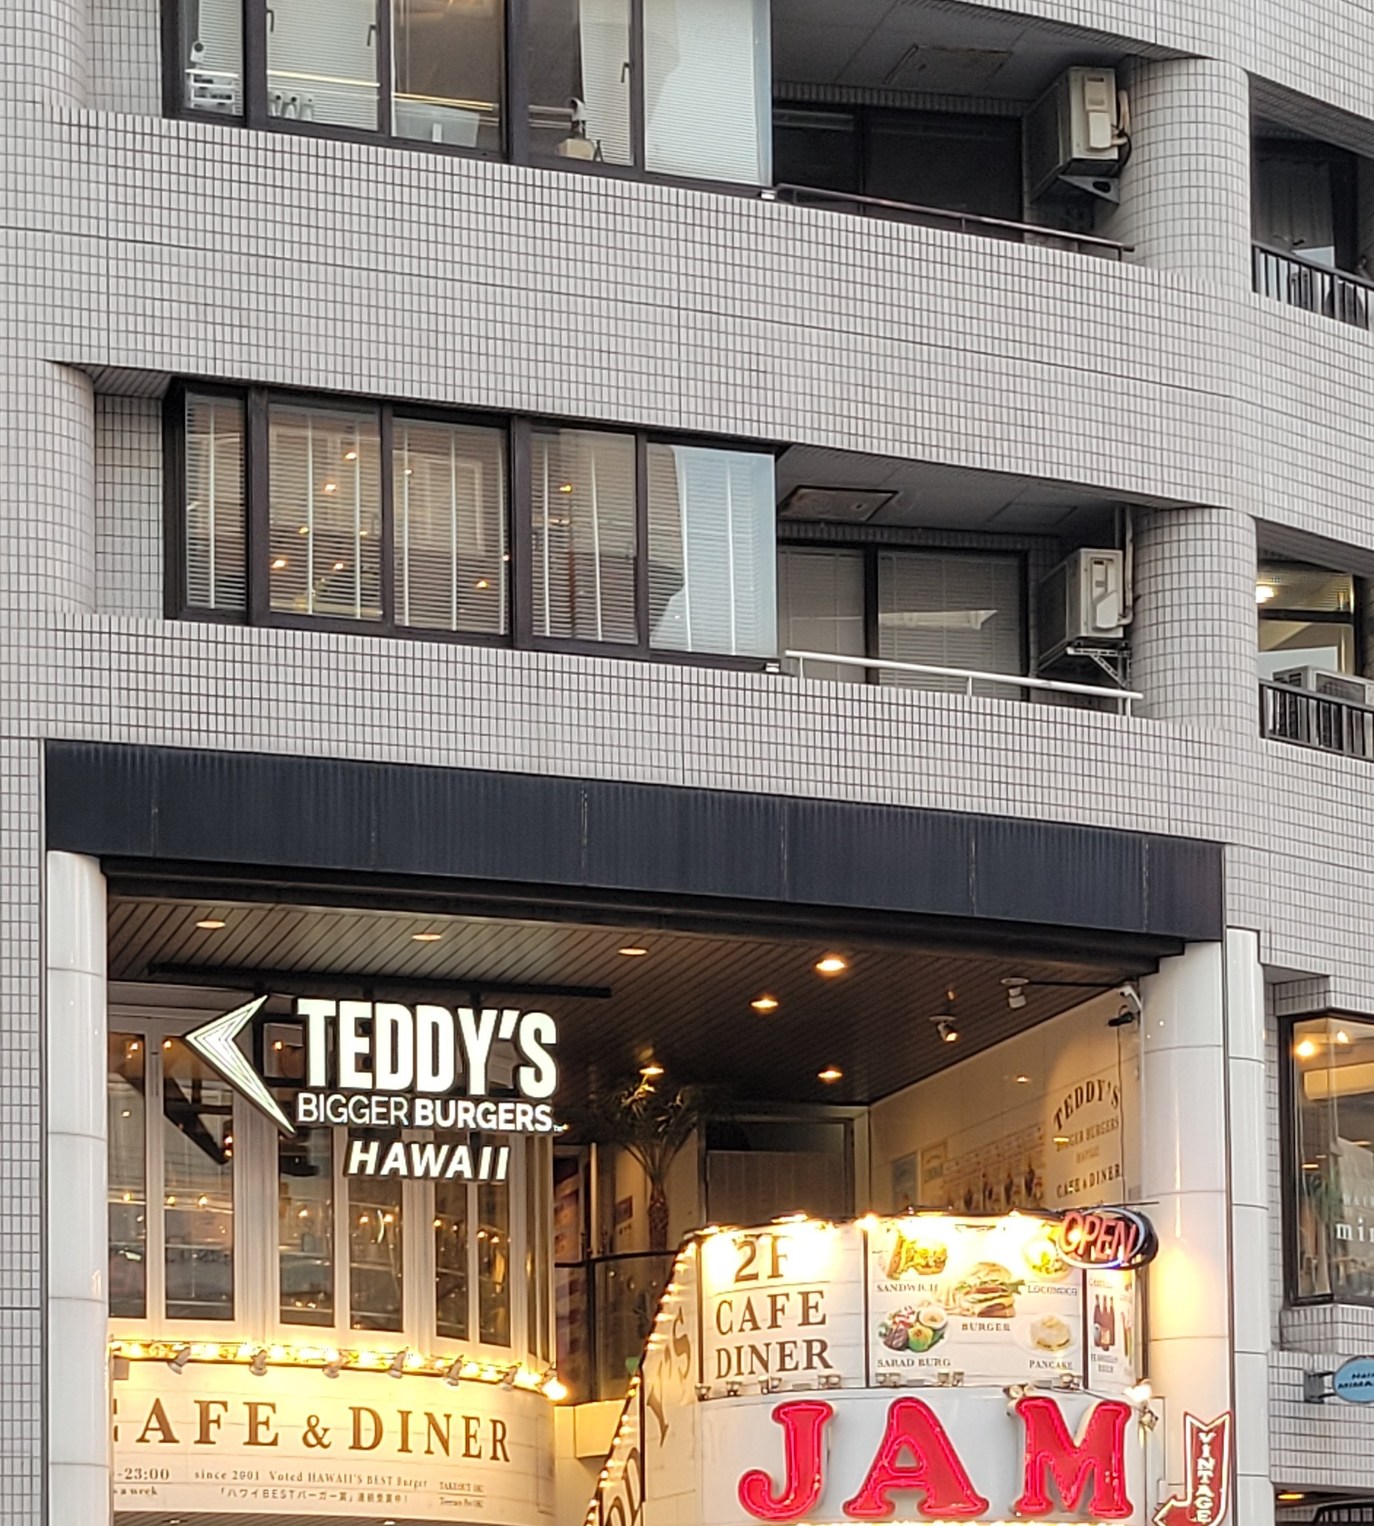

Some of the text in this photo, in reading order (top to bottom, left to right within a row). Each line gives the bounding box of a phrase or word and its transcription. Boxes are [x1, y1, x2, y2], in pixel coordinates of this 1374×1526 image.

[297, 999, 557, 1098] TEDDY'S
[298, 1092, 409, 1126] BIGGER
[414, 1098, 552, 1132] BURGERS
[1053, 1079, 1120, 1131] TEDDY'S
[348, 1140, 510, 1180] HAWAII
[732, 1236, 790, 1283] 2F
[1060, 1210, 1136, 1264] OPEN
[715, 1290, 827, 1336] CAFE
[961, 1322, 1011, 1332] BURGER
[715, 1338, 833, 1379] DINER
[1028, 1359, 1073, 1369] PANCAKE
[113, 1398, 510, 1462] AFE & DINER
[194, 1469, 227, 1480] since
[269, 1470, 303, 1482] Voted
[308, 1472, 363, 1484] HAWAII'S
[367, 1475, 392, 1486] BEST
[737, 1396, 1134, 1519] JAM
[1194, 1432, 1216, 1523] VINTAGE
